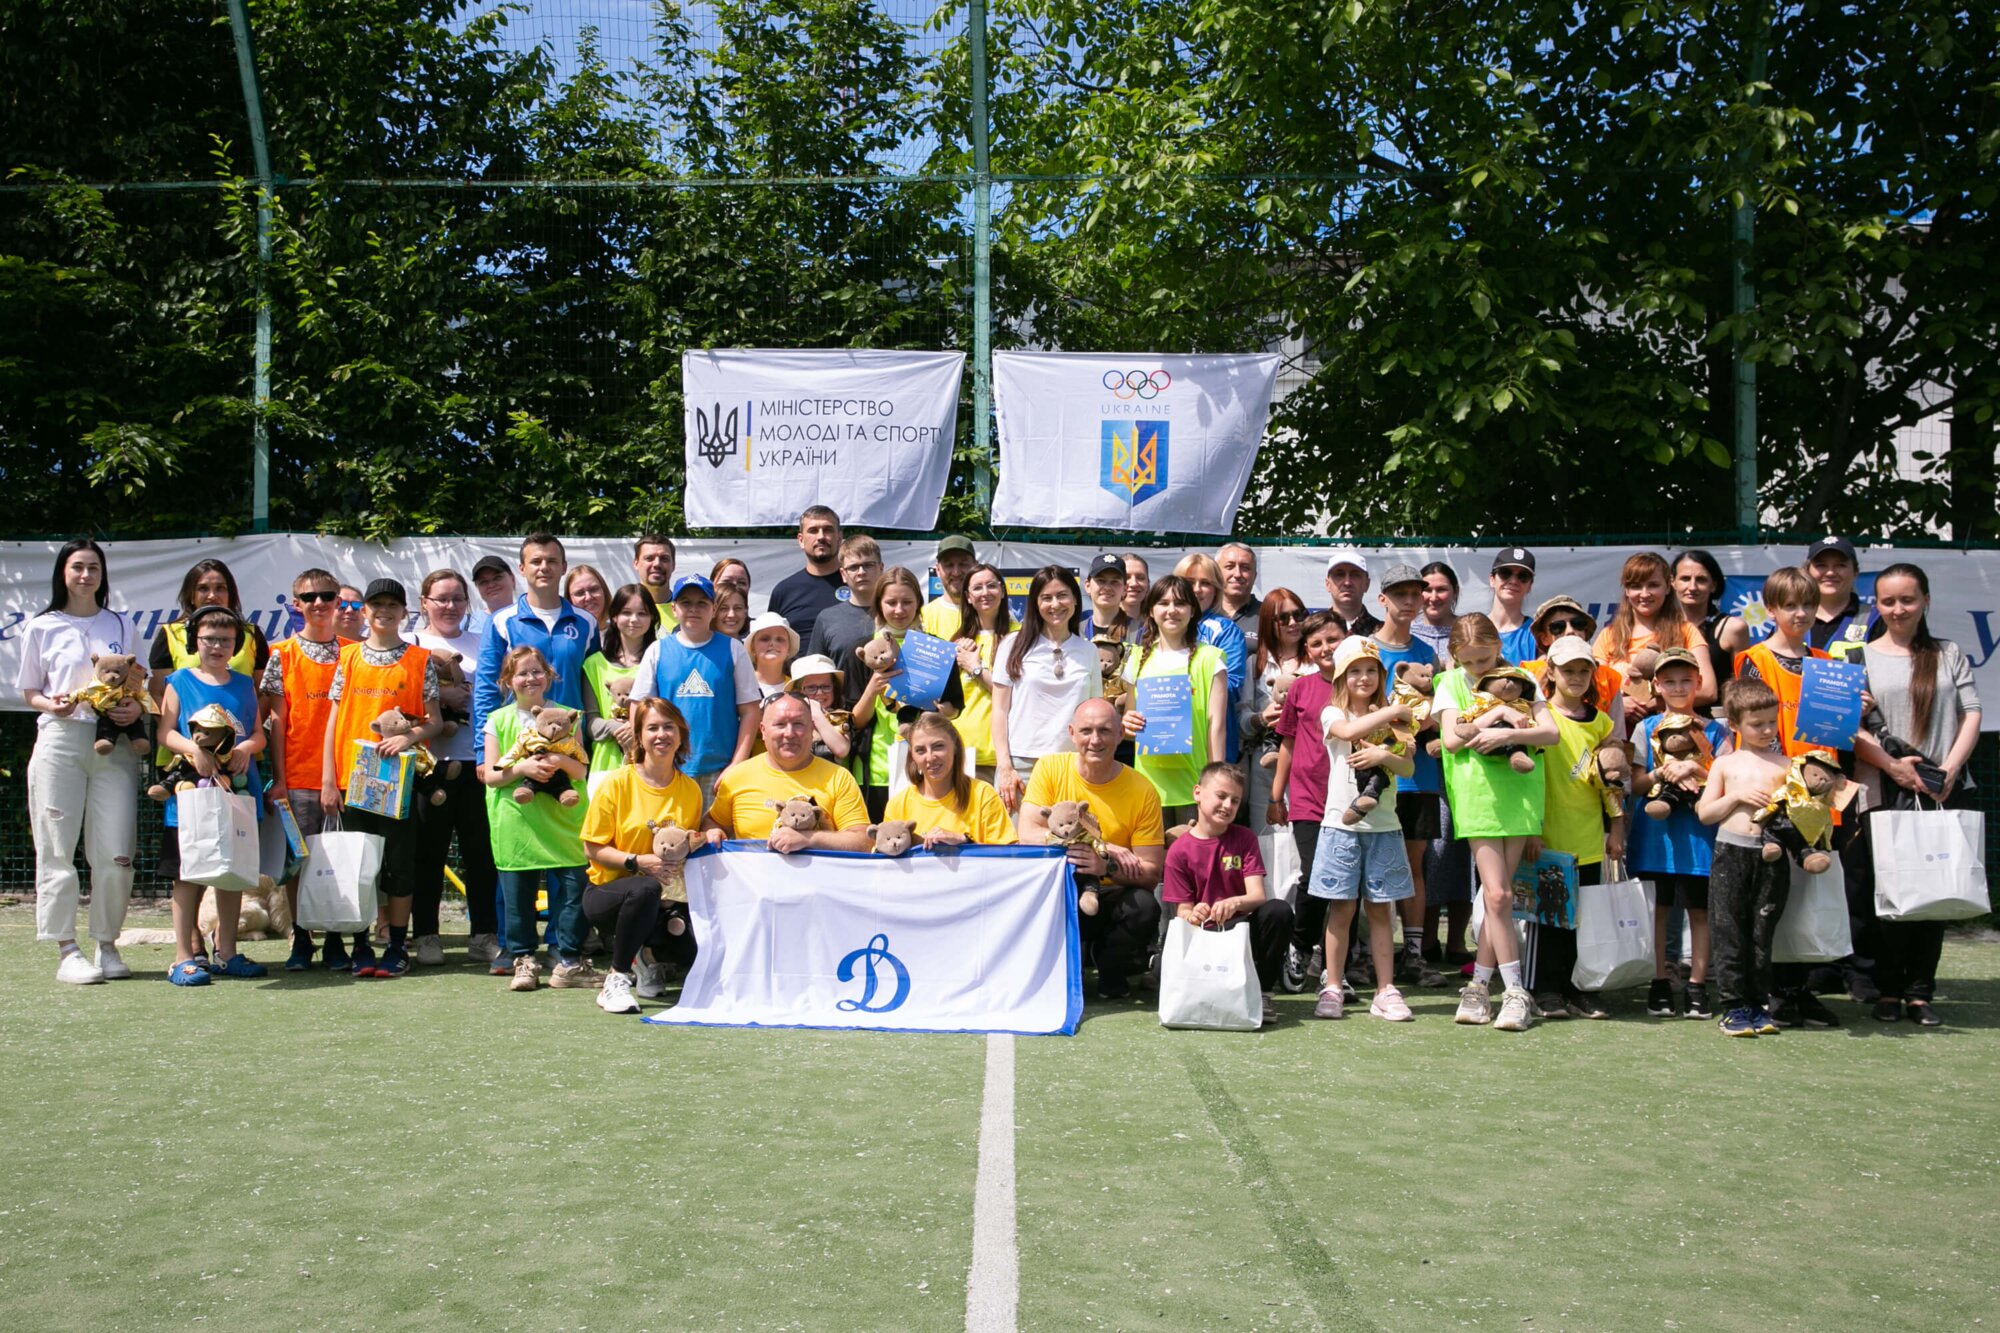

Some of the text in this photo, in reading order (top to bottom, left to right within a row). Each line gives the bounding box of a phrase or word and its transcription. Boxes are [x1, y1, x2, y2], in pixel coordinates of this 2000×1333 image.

[760, 399, 894, 417] МІНІСТЕРСТВО
[1101, 404, 1171, 415] UKRAINE
[760, 424, 840, 442] МОЛОДІ
[846, 424, 868, 441] ТА
[759, 446, 837, 467] УКРАЇНИ
